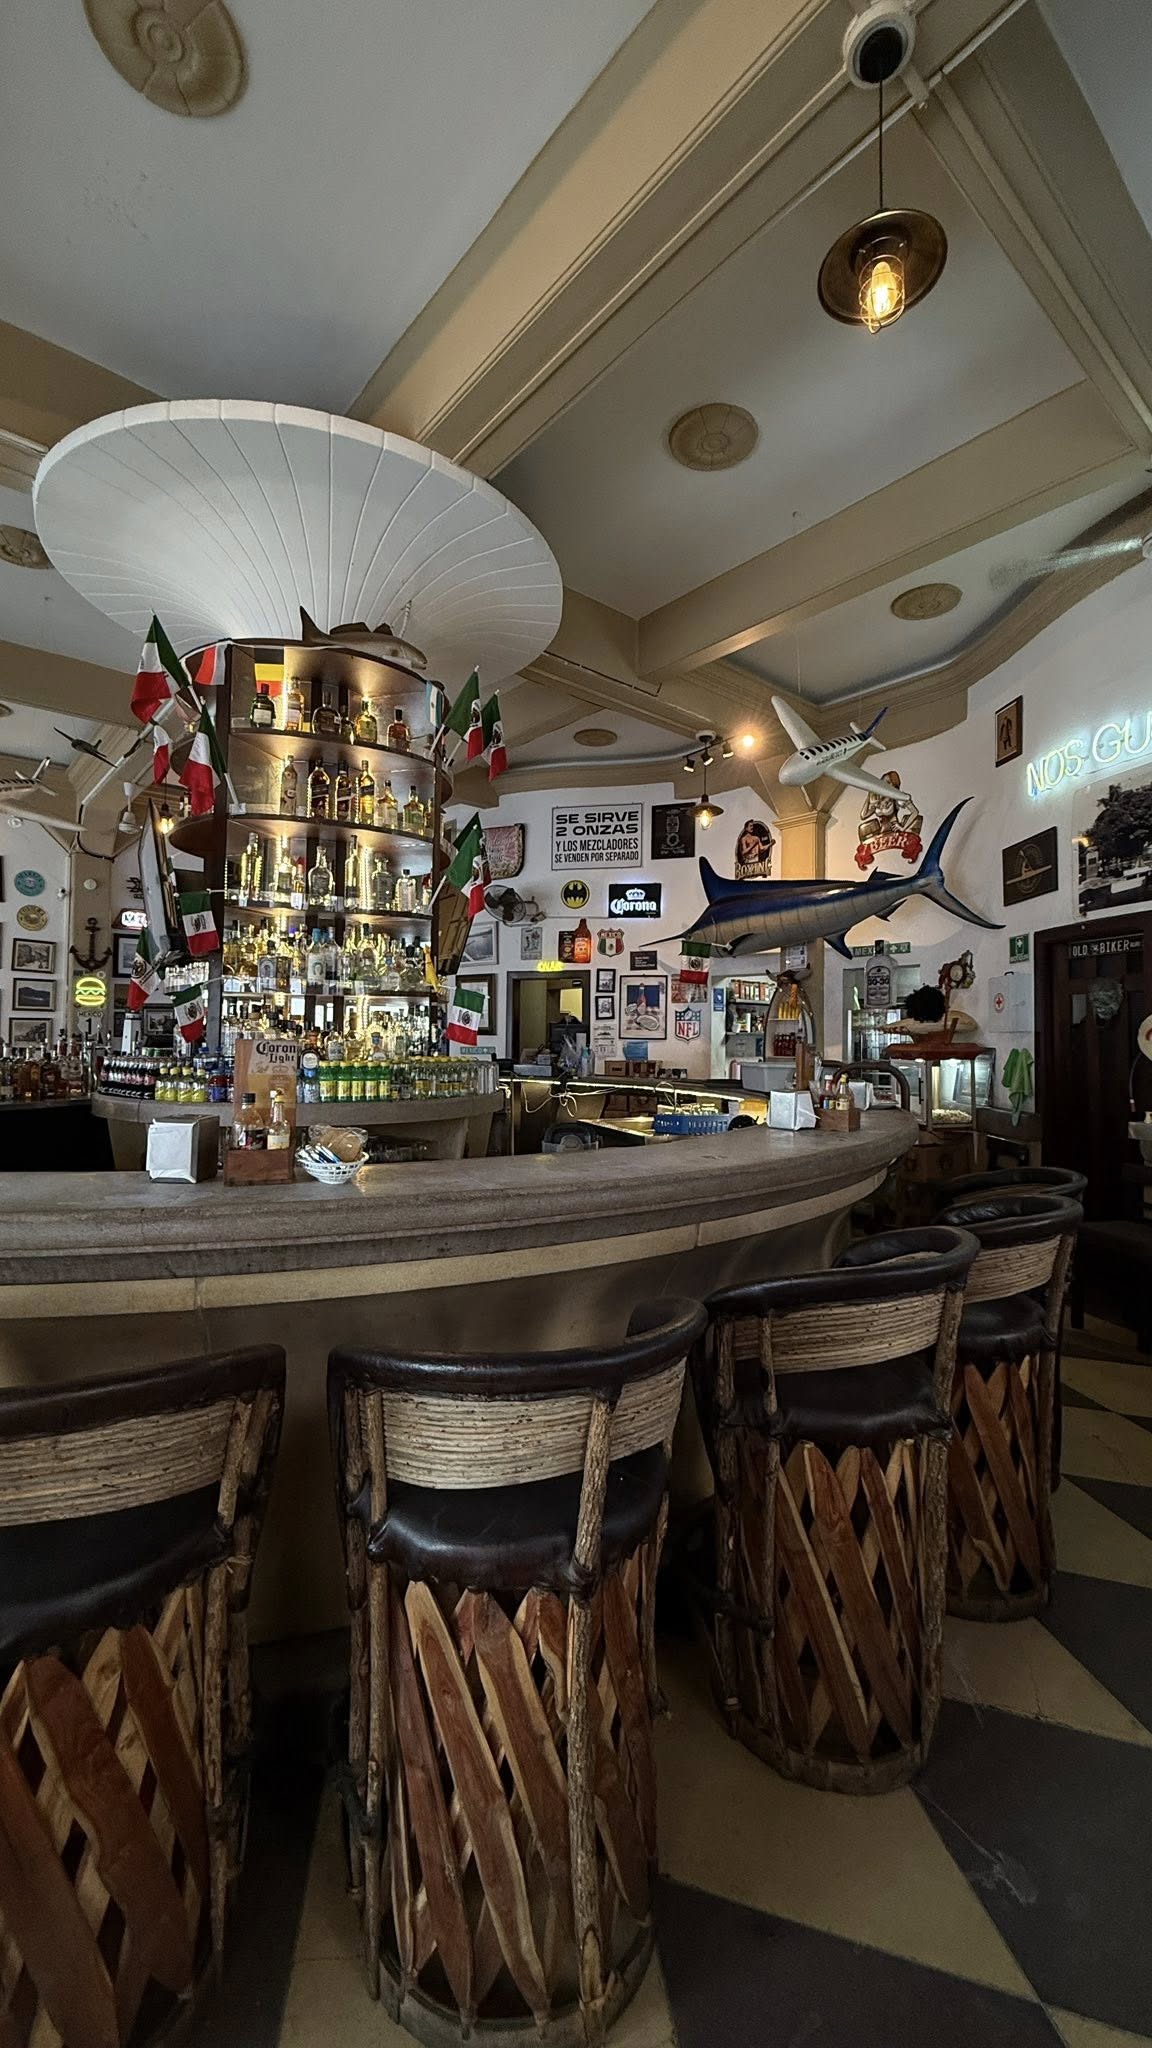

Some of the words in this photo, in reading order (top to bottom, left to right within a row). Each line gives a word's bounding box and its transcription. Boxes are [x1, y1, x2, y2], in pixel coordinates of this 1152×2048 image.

[1026, 739, 1084, 797] NOS
[555, 813, 579, 825] SE
[584, 810, 639, 823] SIRVE
[555, 826, 567, 836] 2
[572, 823, 639, 836] ONZAS
[555, 840, 561, 852] Y
[563, 840, 578, 852] LOS
[580, 837, 639, 851] MEZCLADORES
[871, 833, 908, 850] BEER
[554, 853, 563, 863] SE
[564, 852, 590, 863] VENDEN
[591, 852, 604, 862] POR
[605, 850, 639, 862] SEPARADO
[735, 858, 772, 880] BOXING
[610, 898, 657, 915] Corona
[1072, 944, 1088, 957] OLD
[1100, 939, 1130, 954] BIKER
[85, 1017, 92, 1035] 1
[677, 1022, 699, 1038] NFL
[269, 1053, 295, 1063] Light
